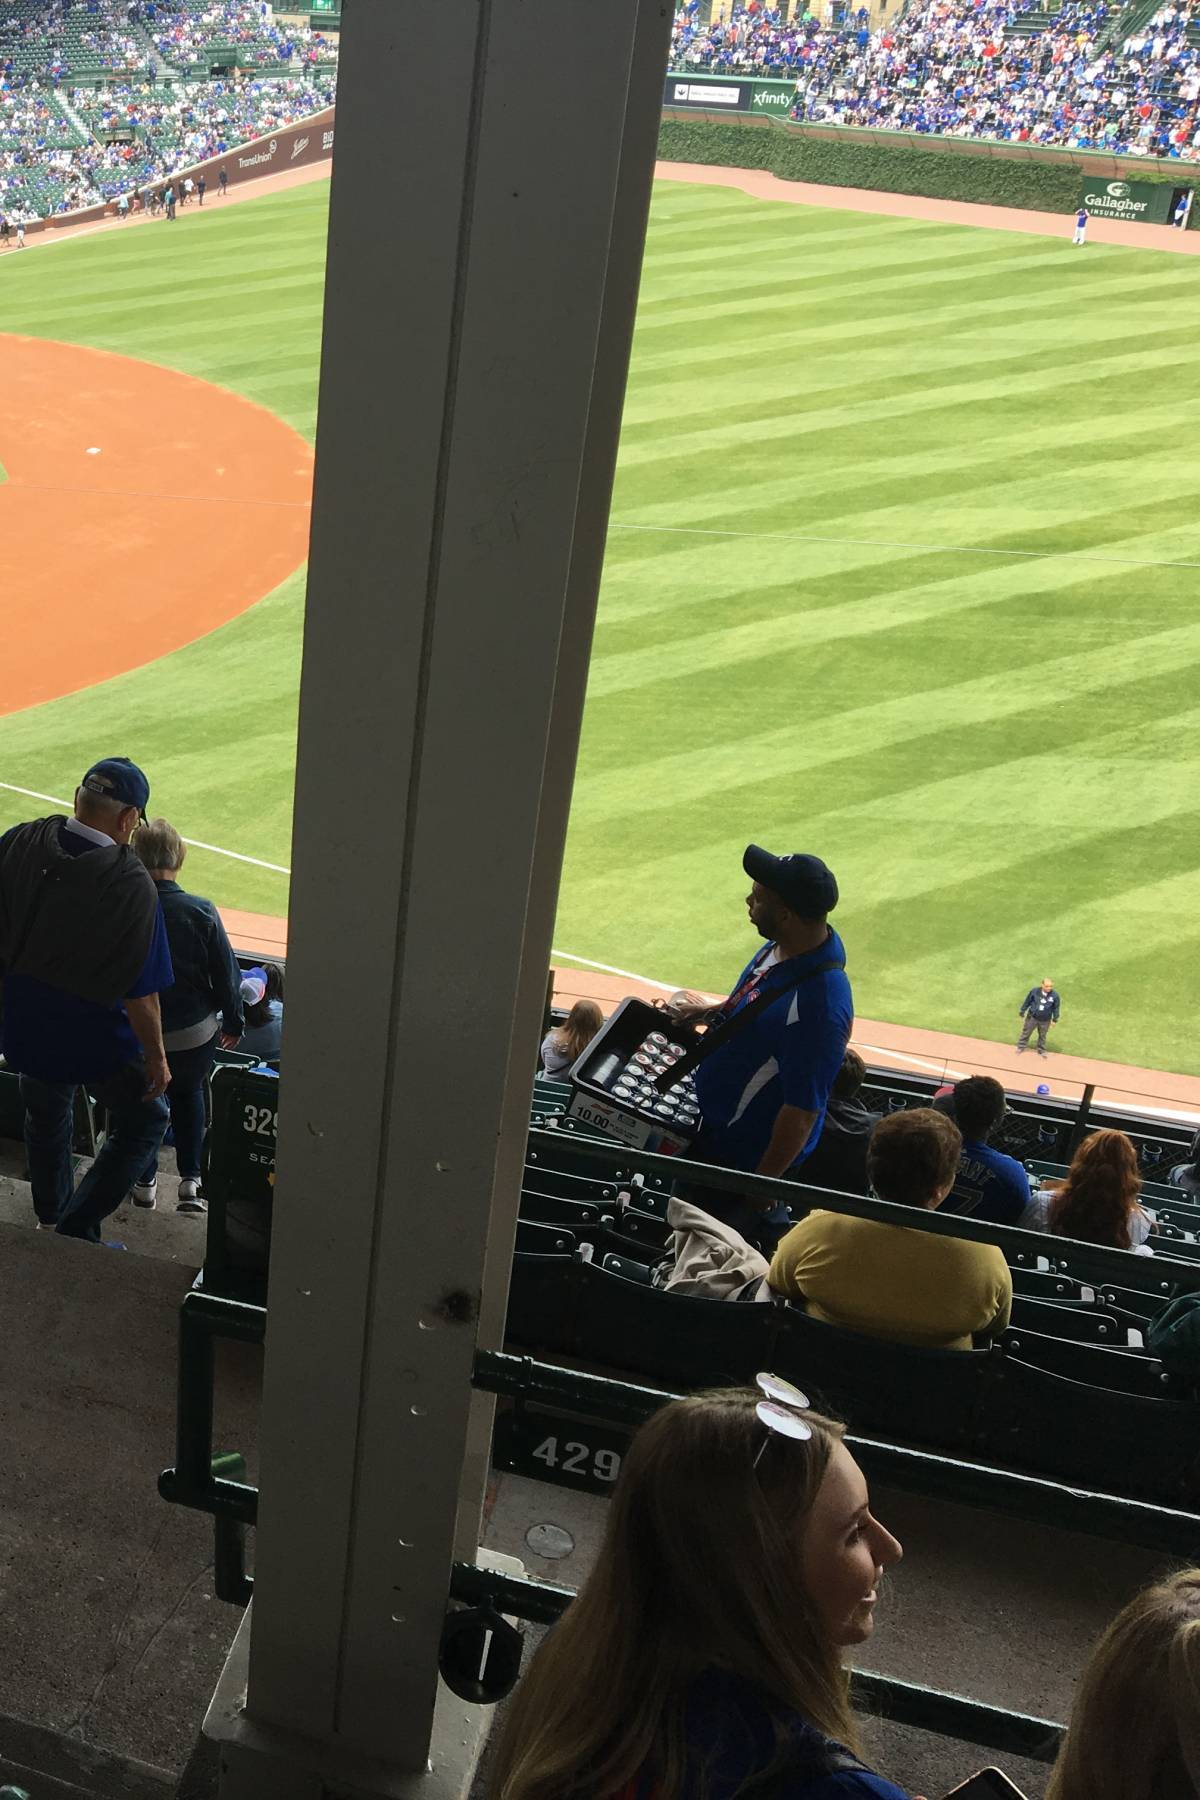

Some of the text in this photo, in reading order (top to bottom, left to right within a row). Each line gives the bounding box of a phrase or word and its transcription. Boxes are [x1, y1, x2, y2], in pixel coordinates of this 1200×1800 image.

[753, 90, 793, 108] xfinity
[238, 152, 272, 168] TransUnion
[1084, 193, 1148, 211] Gallagher
[1090, 208, 1136, 219] INSURANCE
[577, 1106, 610, 1129] 10.00
[532, 1436, 621, 1482] 429
